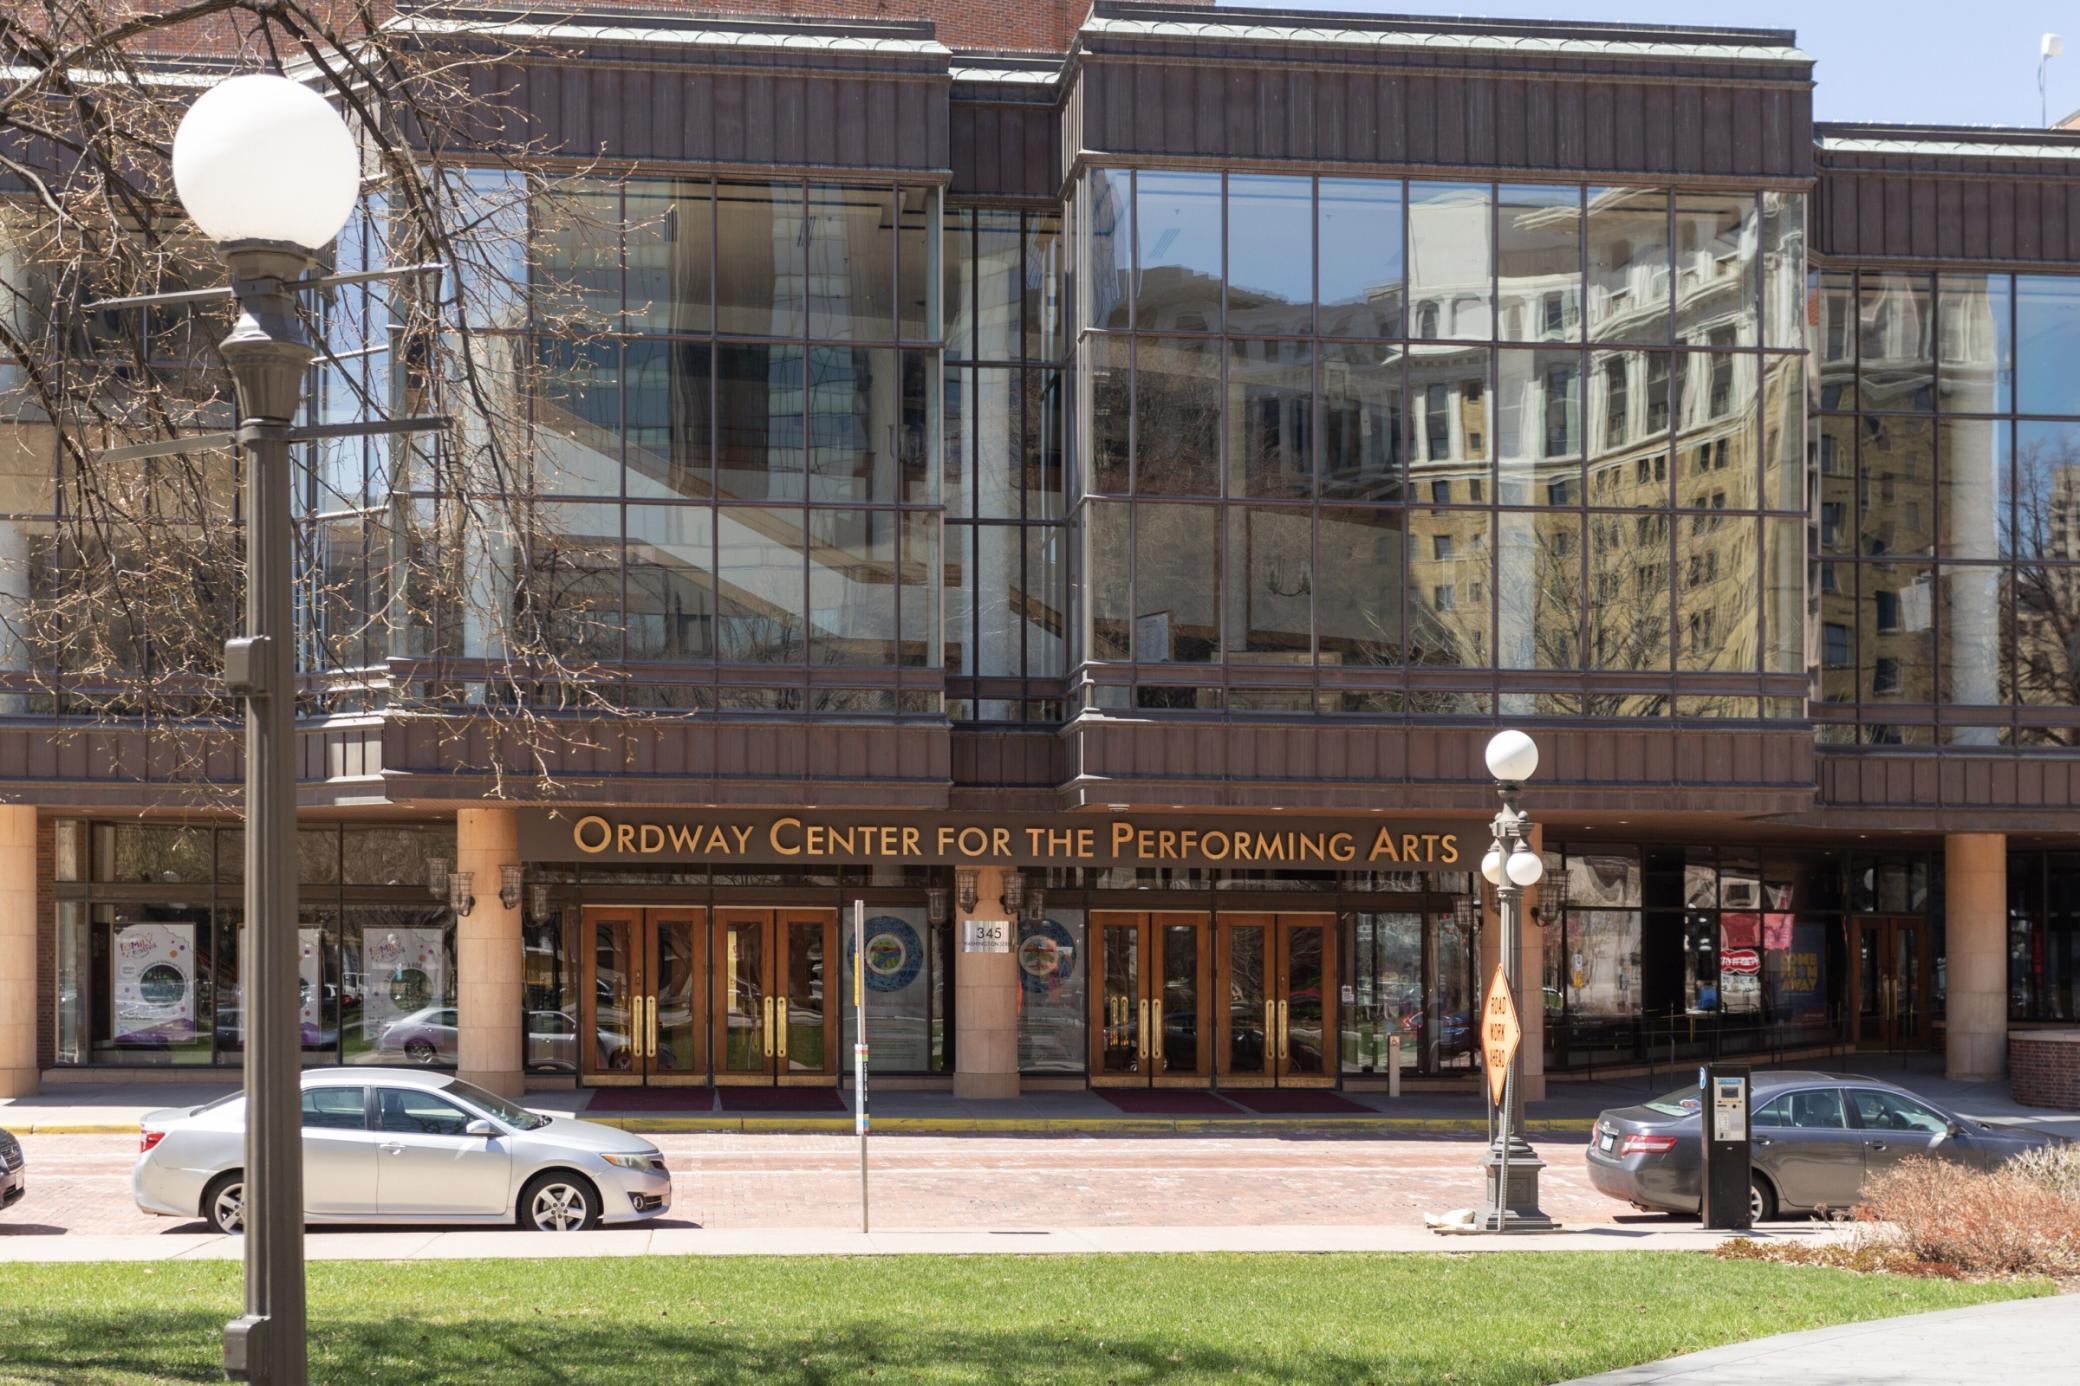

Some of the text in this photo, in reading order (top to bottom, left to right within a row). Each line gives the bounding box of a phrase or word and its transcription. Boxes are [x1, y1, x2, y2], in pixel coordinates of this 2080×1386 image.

[573, 815, 1459, 864] ORDWAY CENTER FOR THE PERFORMING ARTS
[976, 927, 1002, 939] 345
[1490, 996, 1506, 1015] ROAD
[1490, 1023, 1505, 1041] WORK
[1490, 1049, 1505, 1067] AHEAD
